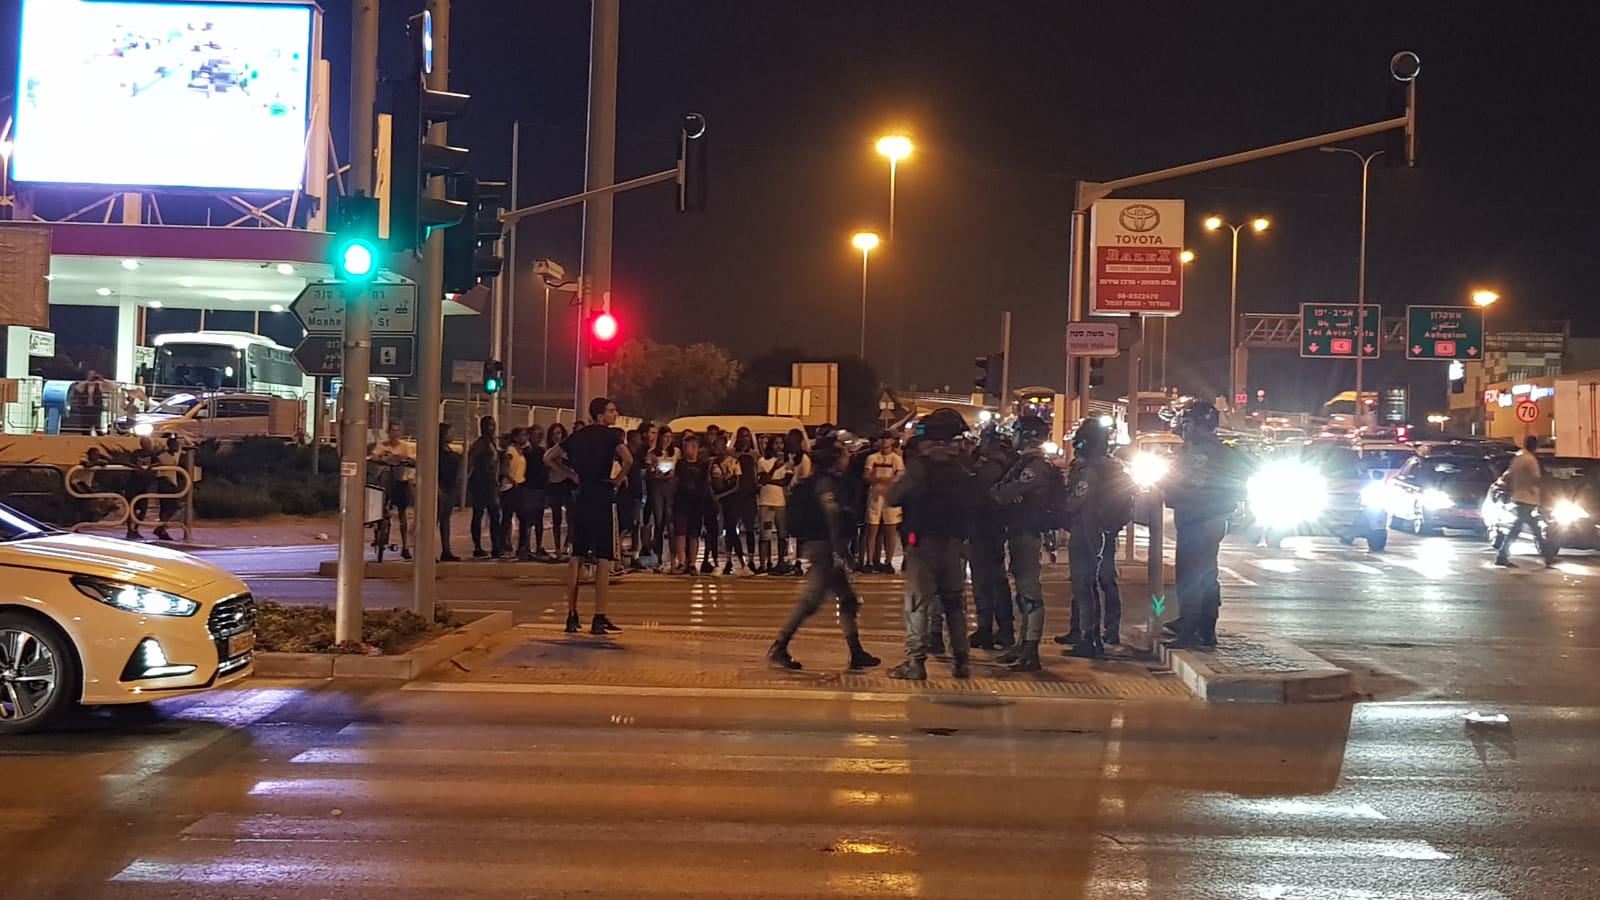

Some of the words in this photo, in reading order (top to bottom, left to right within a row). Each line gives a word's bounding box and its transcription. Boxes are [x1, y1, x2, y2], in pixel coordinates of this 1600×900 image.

[1115, 235, 1163, 244] TOYOTA
[308, 317, 341, 327] Moshe
[378, 317, 390, 327] St
[1307, 328, 1322, 336] Tel
[1521, 406, 1536, 418] 70
